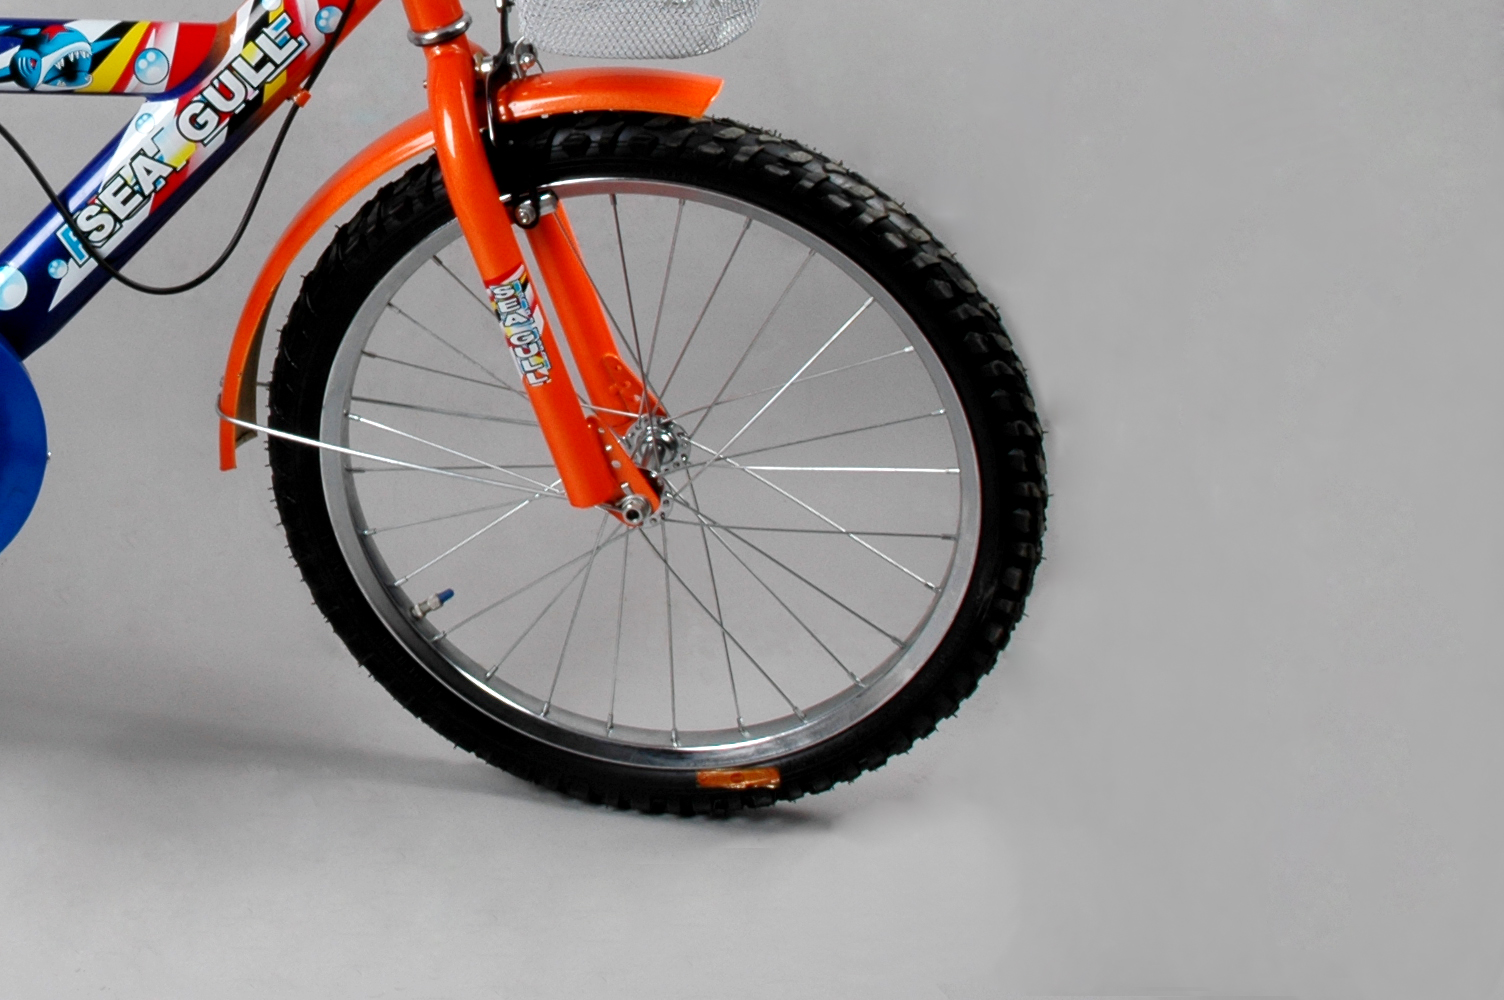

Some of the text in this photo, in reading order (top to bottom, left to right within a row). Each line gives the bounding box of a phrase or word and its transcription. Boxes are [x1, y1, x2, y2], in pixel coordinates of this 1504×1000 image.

[75, 30, 301, 244] SEA GULL
[492, 284, 550, 385] SEA GULL
